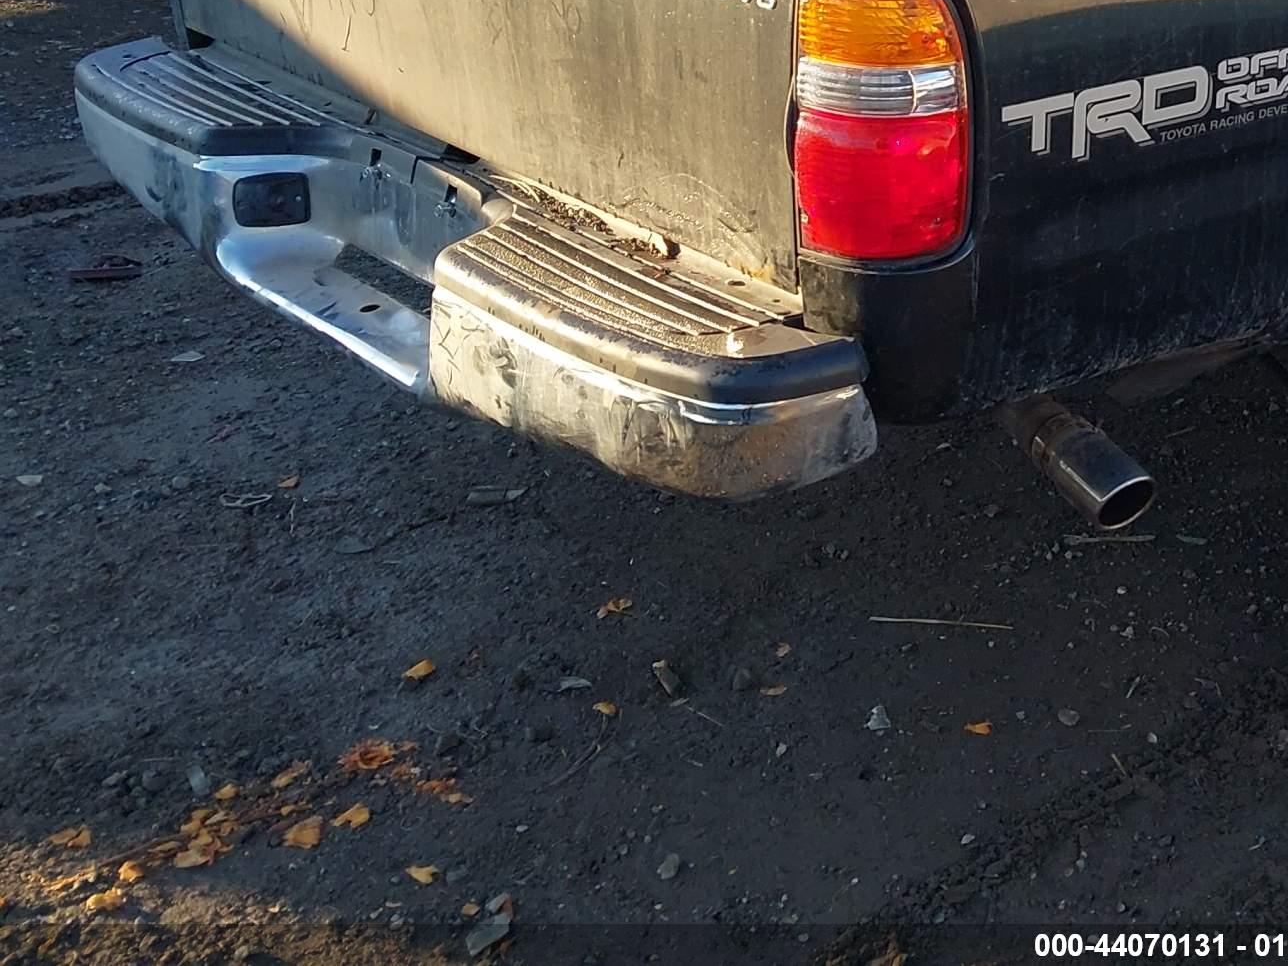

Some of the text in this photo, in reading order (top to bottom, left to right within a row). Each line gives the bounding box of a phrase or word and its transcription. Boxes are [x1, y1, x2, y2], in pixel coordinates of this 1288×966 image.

[1001, 64, 1214, 163] TRD
[1159, 122, 1208, 144] TOYOTA
[1209, 109, 1256, 132] RACING
